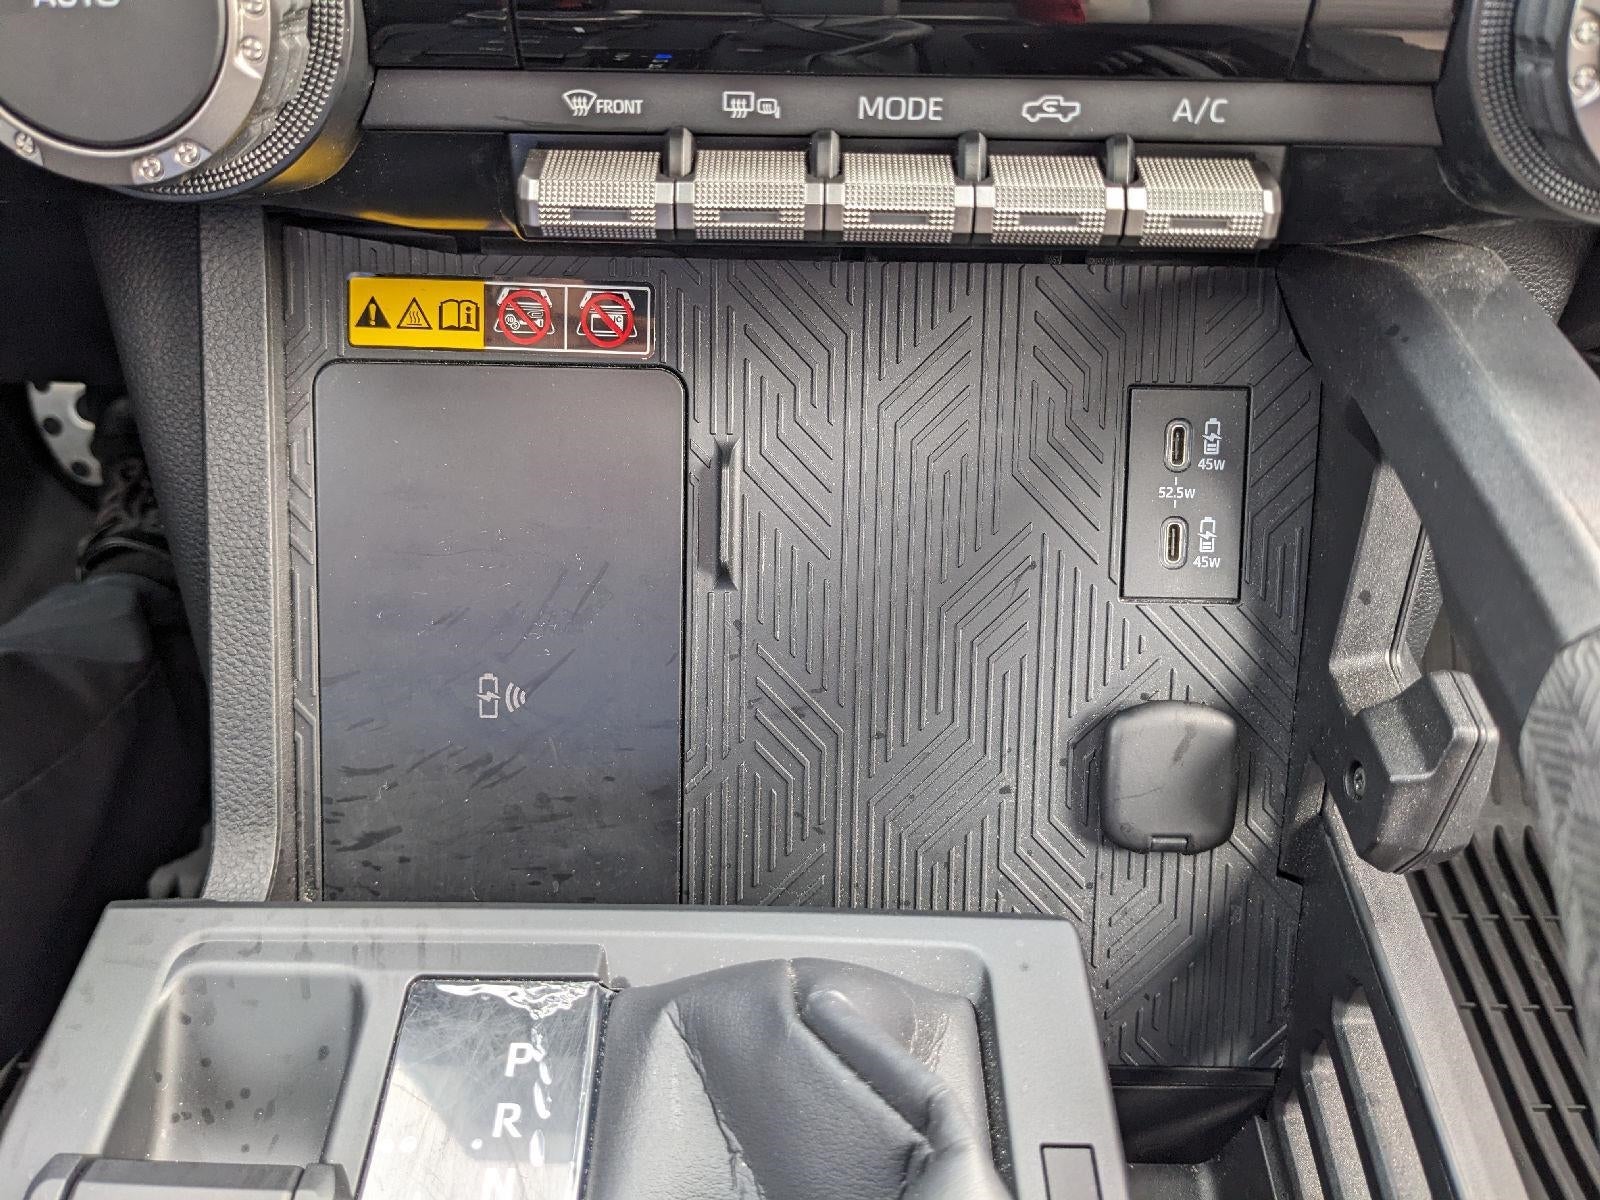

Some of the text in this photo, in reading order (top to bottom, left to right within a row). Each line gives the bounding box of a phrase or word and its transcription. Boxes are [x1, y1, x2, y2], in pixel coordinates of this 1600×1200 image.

[596, 98, 643, 115] FRONT
[858, 96, 944, 121] MODE
[1172, 96, 1228, 124] A/C
[1197, 459, 1226, 471] 45W
[1158, 486, 1196, 499] 52.5W
[1193, 556, 1221, 568] 45W
[504, 1042, 534, 1077] P
[492, 1102, 522, 1138] R
[479, 1167, 516, 1200] N
